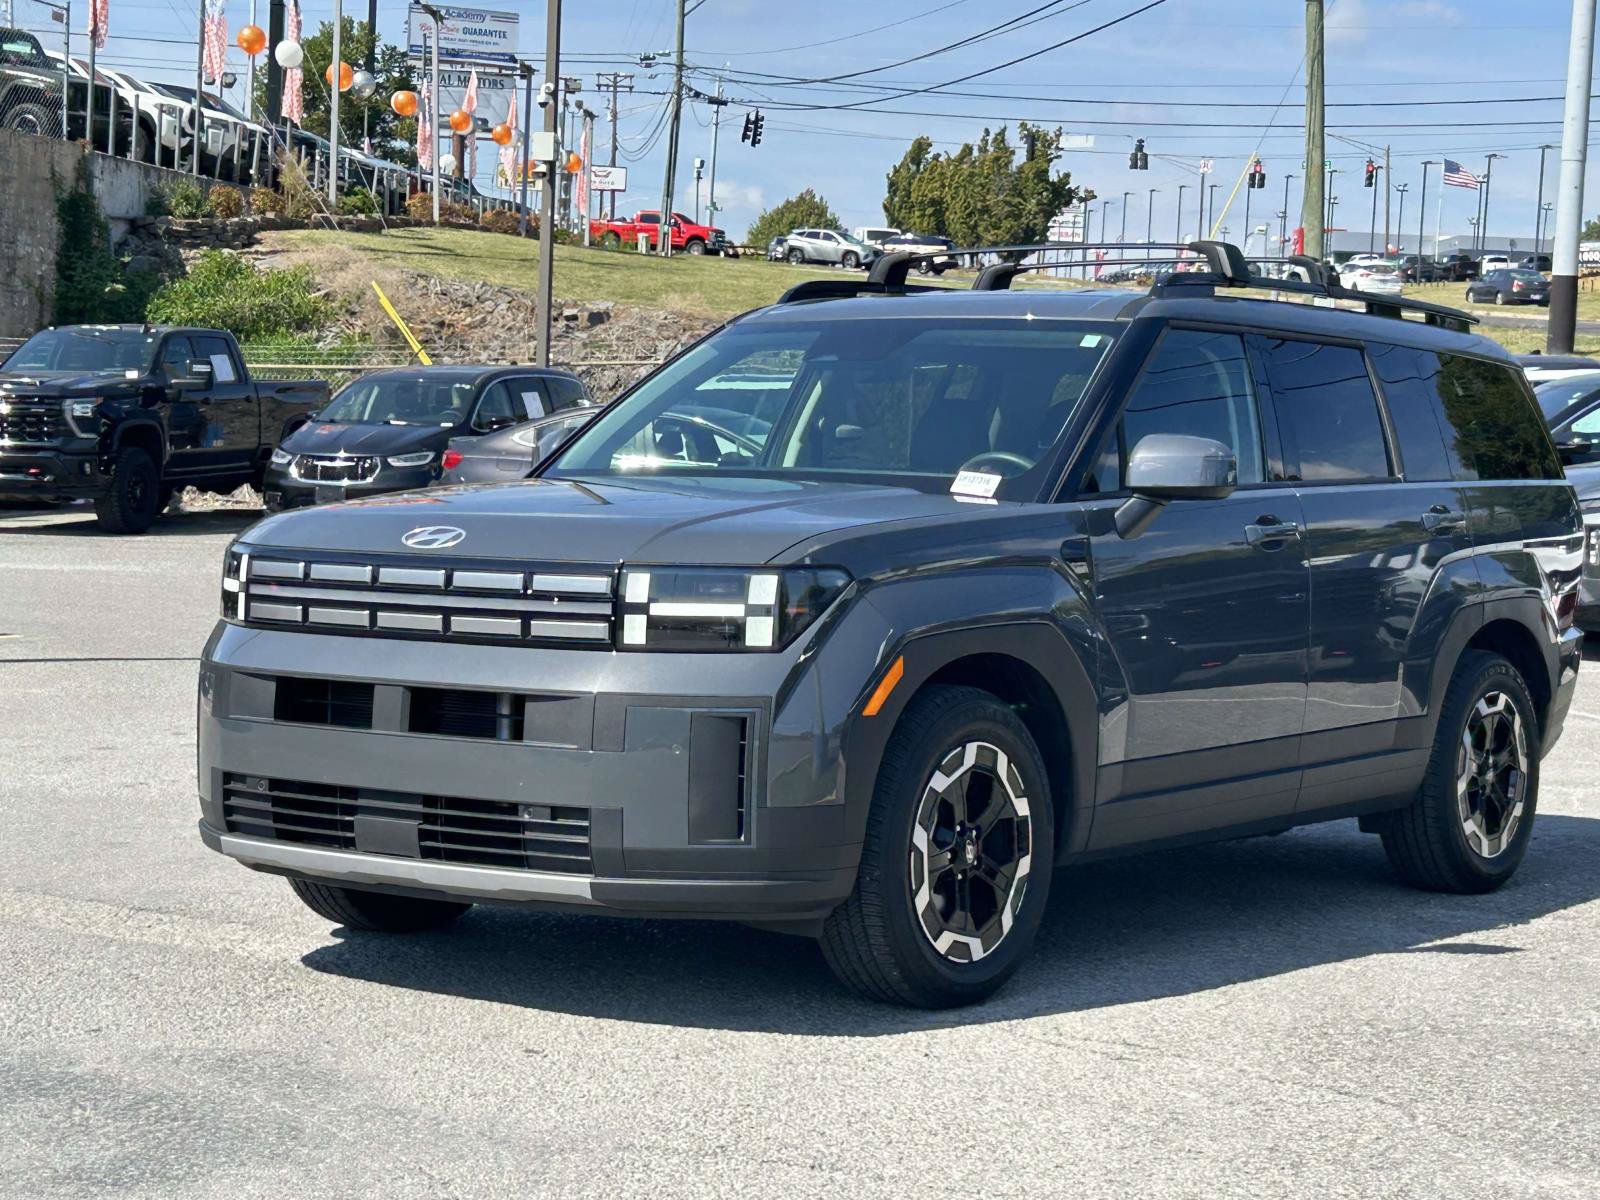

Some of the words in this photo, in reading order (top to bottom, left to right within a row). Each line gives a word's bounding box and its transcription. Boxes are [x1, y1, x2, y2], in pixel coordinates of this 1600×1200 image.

[444, 8, 487, 23] Academy
[462, 26, 508, 40] GUARANTEE
[416, 72, 454, 85] ROAL
[457, 74, 505, 88] MTORS
